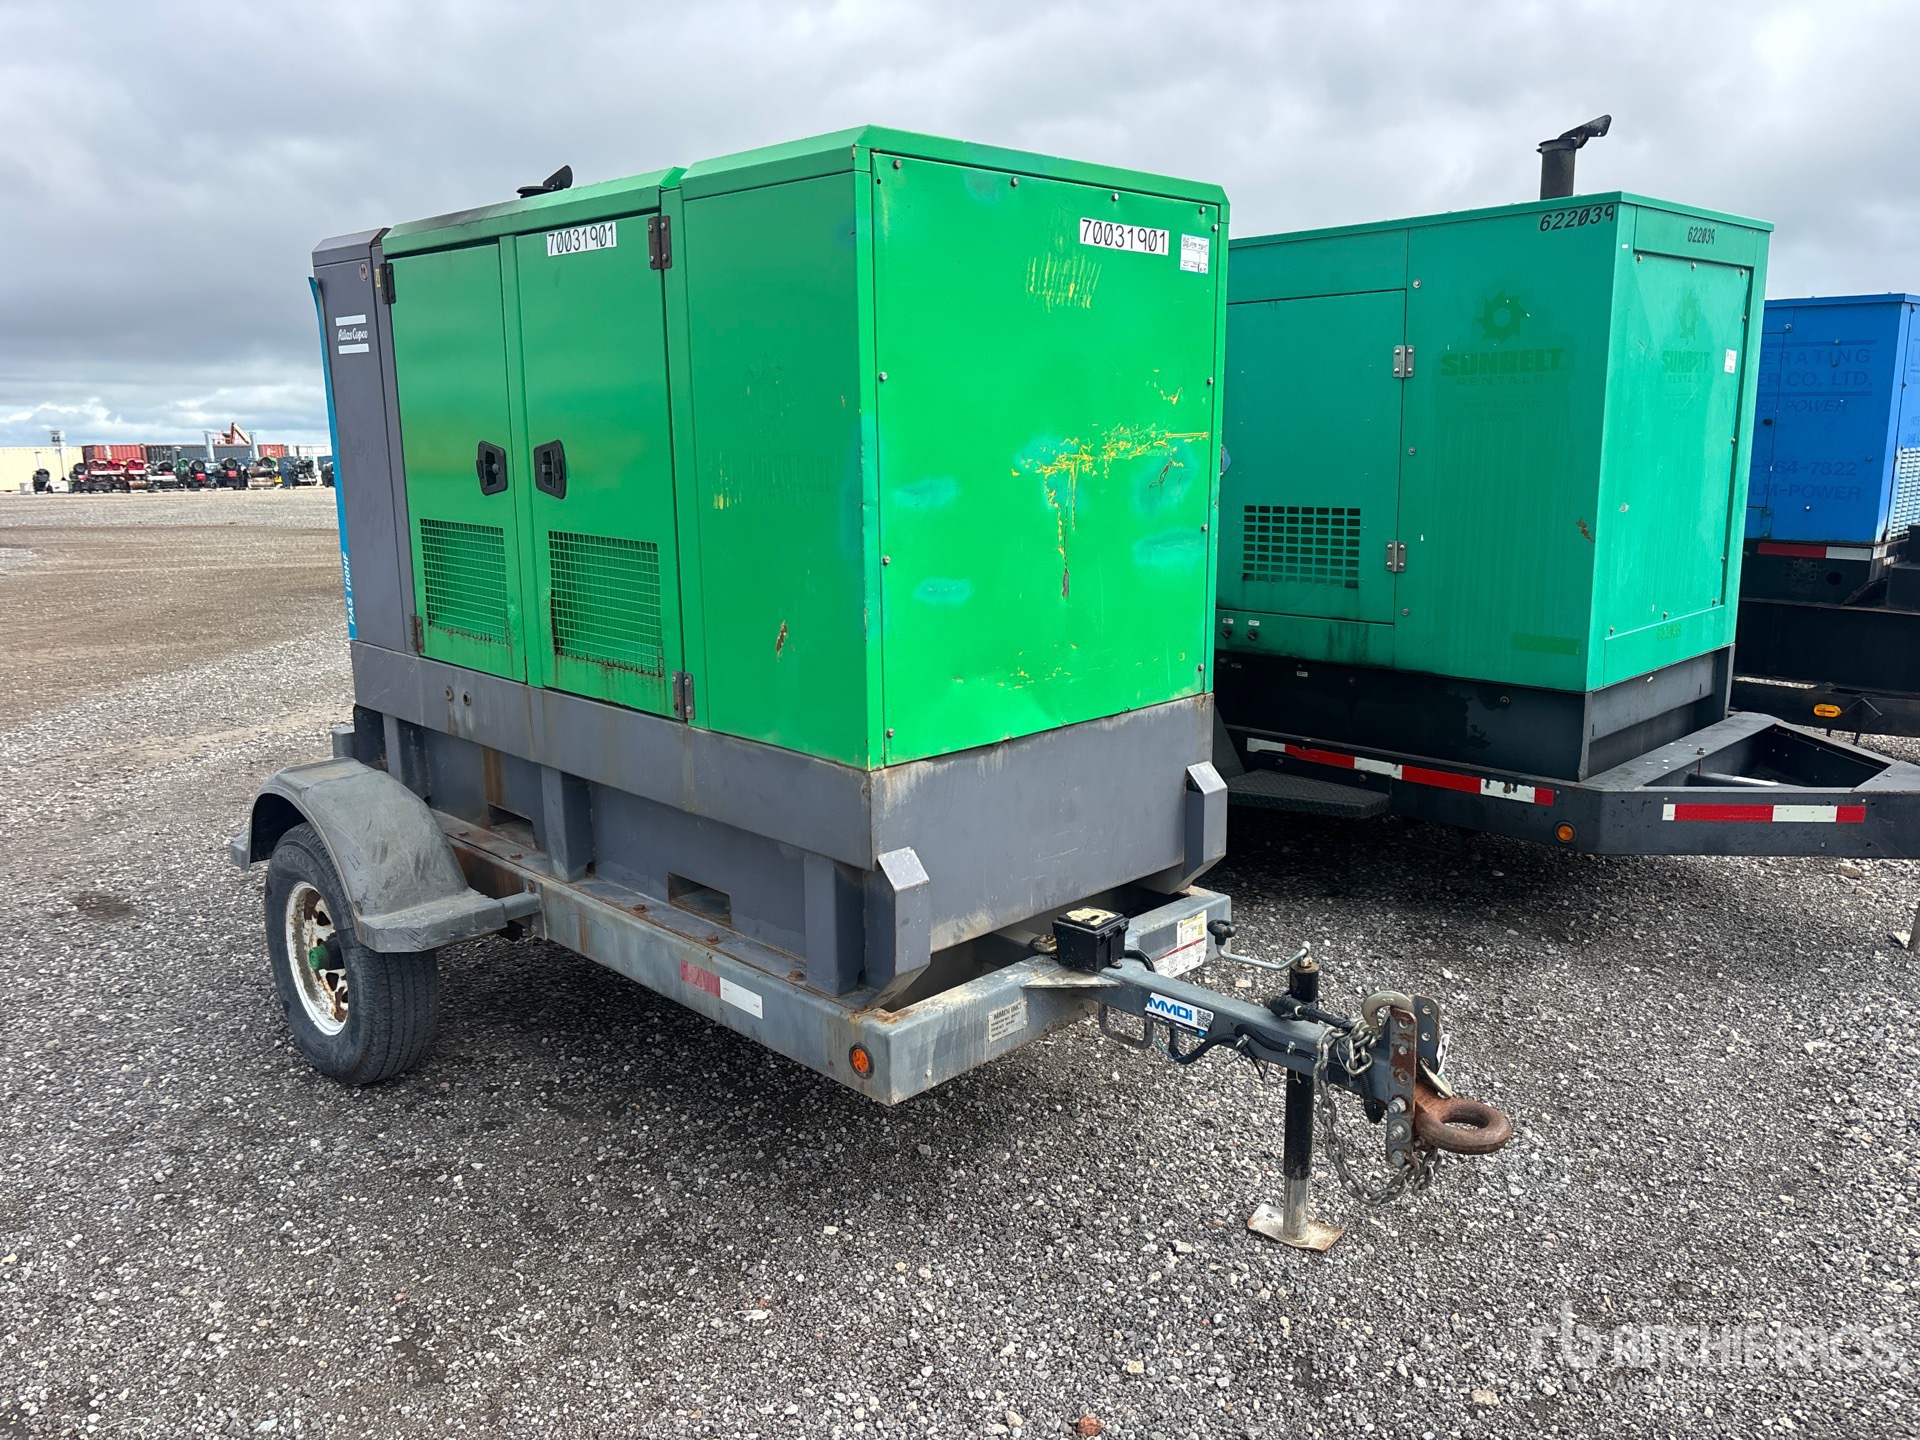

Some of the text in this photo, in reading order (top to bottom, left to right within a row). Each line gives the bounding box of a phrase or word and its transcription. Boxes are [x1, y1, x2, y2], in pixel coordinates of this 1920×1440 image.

[1539, 204, 1615, 232] 622039
[547, 223, 614, 255] 70031901
[1081, 218, 1166, 254] 70031901
[1687, 226, 1716, 245] 622039
[337, 327, 369, 342] Atlas Copco
[1440, 347, 1565, 377] SUNBELT
[342, 551, 356, 625] PAS 100HF
